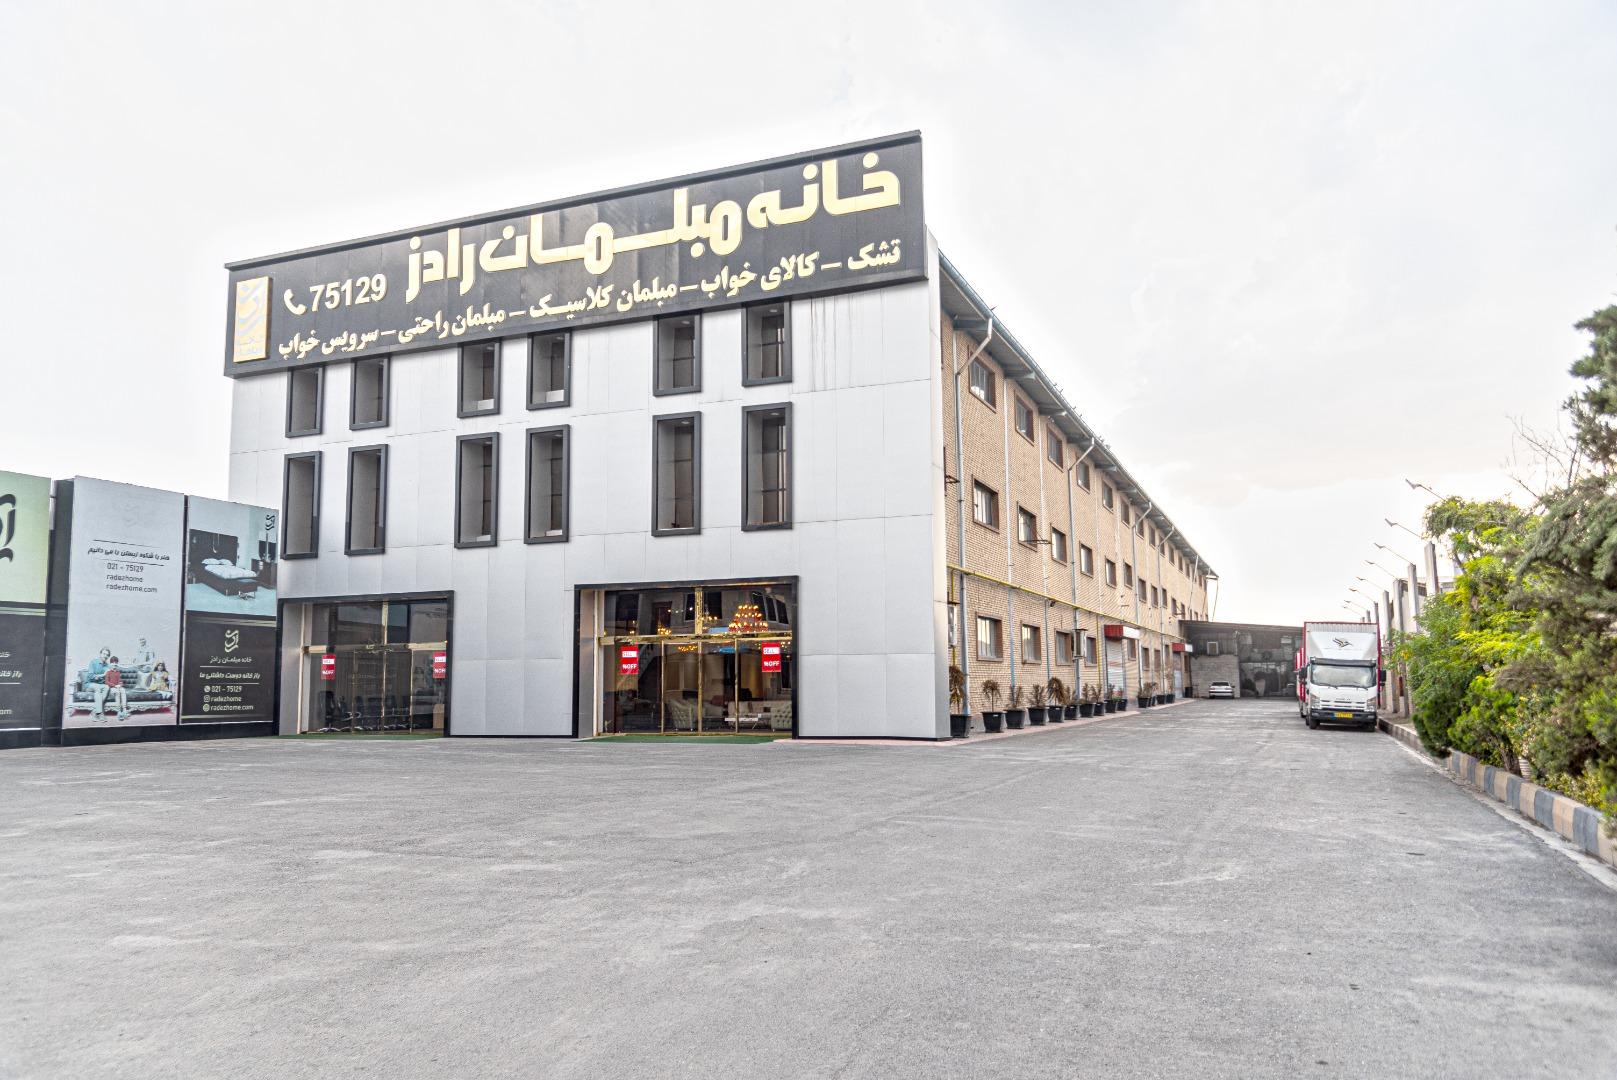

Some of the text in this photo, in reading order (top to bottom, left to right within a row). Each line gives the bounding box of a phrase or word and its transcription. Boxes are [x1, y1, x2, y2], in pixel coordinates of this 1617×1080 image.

[405, 152, 901, 304] خانه مبلمان رادز
[760, 251, 820, 291] کالای
[847, 238, 901, 271] تشک
[309, 272, 388, 312] 75129
[616, 275, 678, 313] مبلمان
[700, 261, 758, 299] خواب
[451, 302, 506, 334] مبلمان
[529, 283, 615, 320] کلاسیک
[321, 328, 380, 354] سرویس
[397, 309, 450, 344] راحتی
[278, 329, 321, 360] خواب
[107, 562, 118, 570] 021
[126, 564, 144, 573] 75129
[106, 584, 157, 593] radezhome.com
[226, 685, 243, 693] 75129
